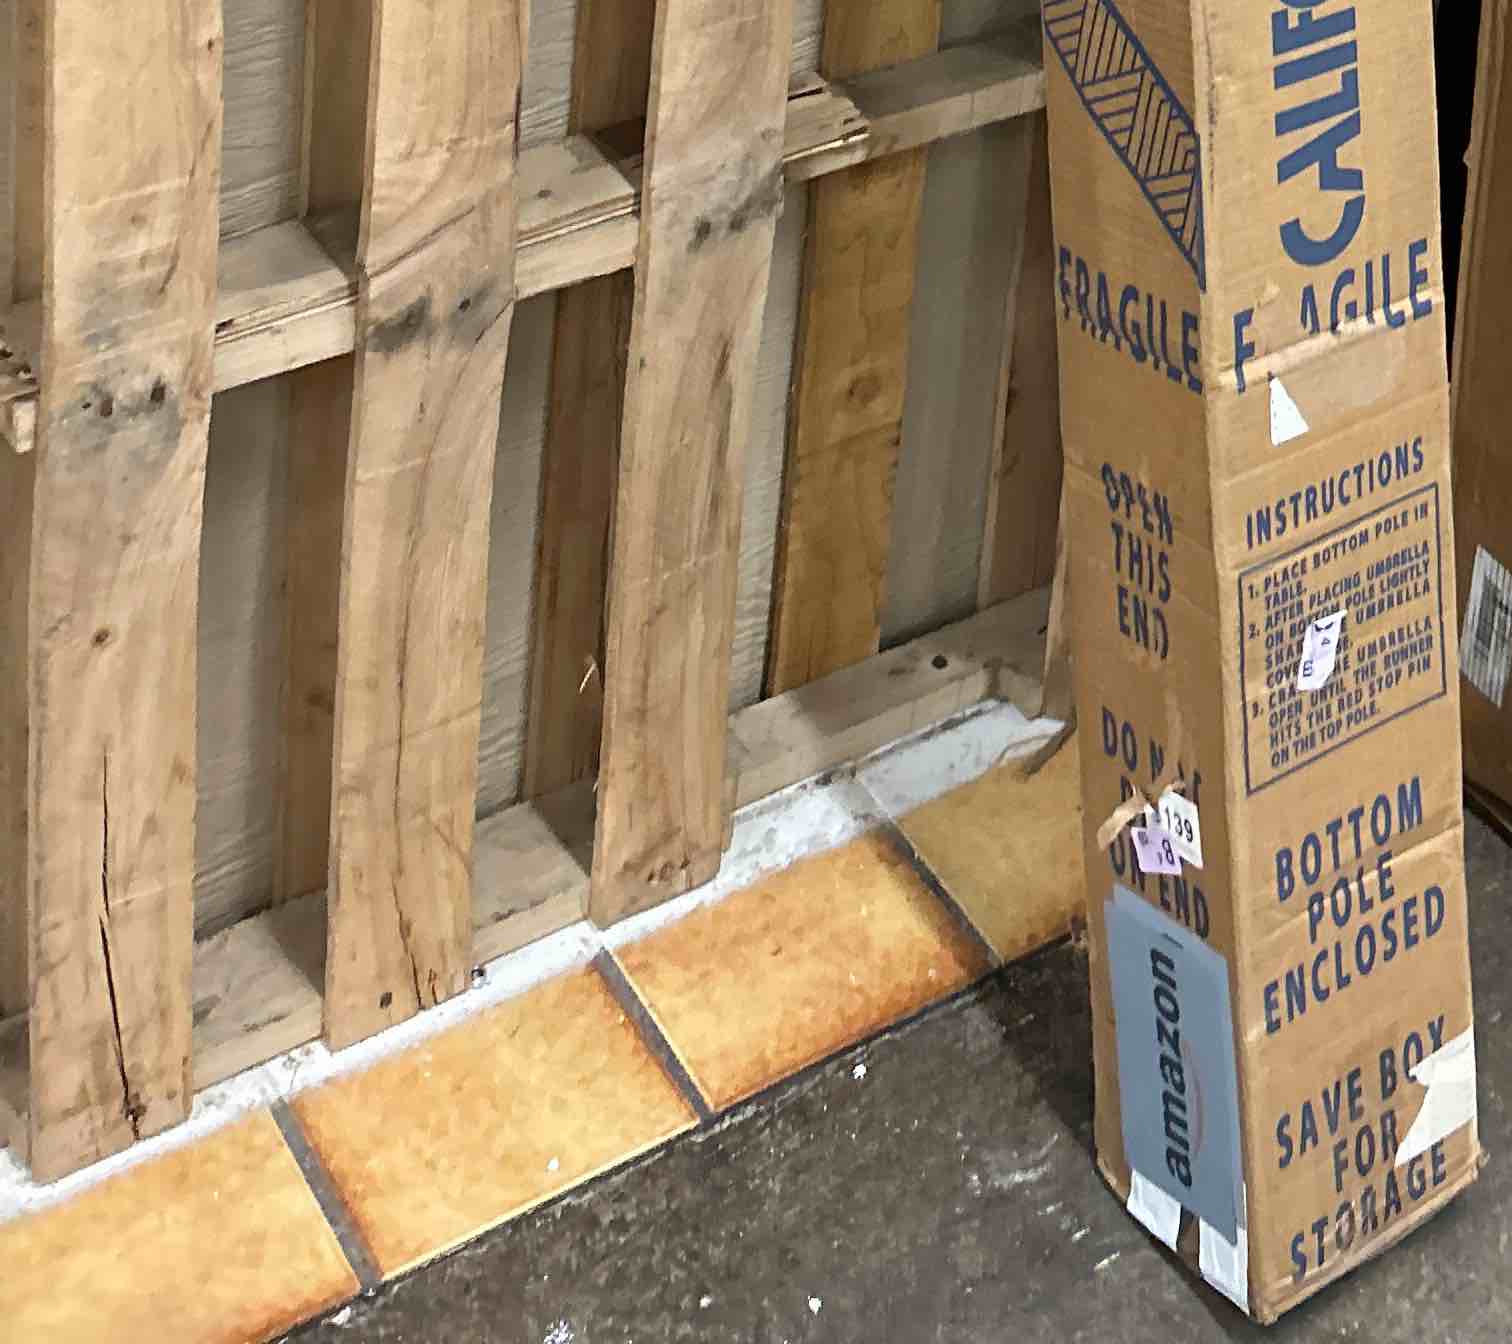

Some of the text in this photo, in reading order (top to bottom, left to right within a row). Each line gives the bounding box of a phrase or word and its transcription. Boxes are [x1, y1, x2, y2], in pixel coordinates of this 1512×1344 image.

[1057, 244, 1204, 394] FRAGILE
[1231, 238, 1433, 395] FAGILE
[1101, 462, 1175, 545] OPEN
[1244, 436, 1425, 549] INSTRUCTIONS
[1112, 524, 1173, 601] THIS
[1248, 502, 1429, 600] 1. PLACE BOTTOM POLE IN
[1248, 624, 1260, 640] 2.
[1264, 602, 1304, 632] AFTER
[1309, 572, 1361, 610] PLACING
[1366, 539, 1430, 581] UMBRELLA
[1263, 582, 1308, 611] TABLE.
[1118, 596, 1169, 659] END
[1265, 632, 1284, 650] ON
[1345, 584, 1375, 610] POLE
[1380, 559, 1430, 594] LIGHTLY
[1355, 578, 1431, 625] UMBRELLA
[1265, 661, 1299, 689] COVE
[1268, 684, 1298, 710] CRA
[1356, 616, 1433, 663] UMBRELLA
[1268, 700, 1303, 729] OPEN
[1309, 681, 1348, 709] UNTIL
[1353, 660, 1378, 683] THE
[1383, 633, 1434, 670] RUNNER
[1268, 653, 1432, 750] HITS THE RED STOP PIN
[1101, 705, 1139, 772] DO
[1270, 700, 1381, 768] ON THE TOP POLE.
[1274, 776, 1425, 904] BOTTOM
[1306, 849, 1396, 947] POLE
[1263, 886, 1447, 1036] ENCLOSED
[1153, 953, 1192, 1189] amazon
[1274, 1014, 1448, 1170] SAVE BOX
[1332, 1113, 1401, 1195] FOR
[1289, 1138, 1449, 1285] STORAGE
